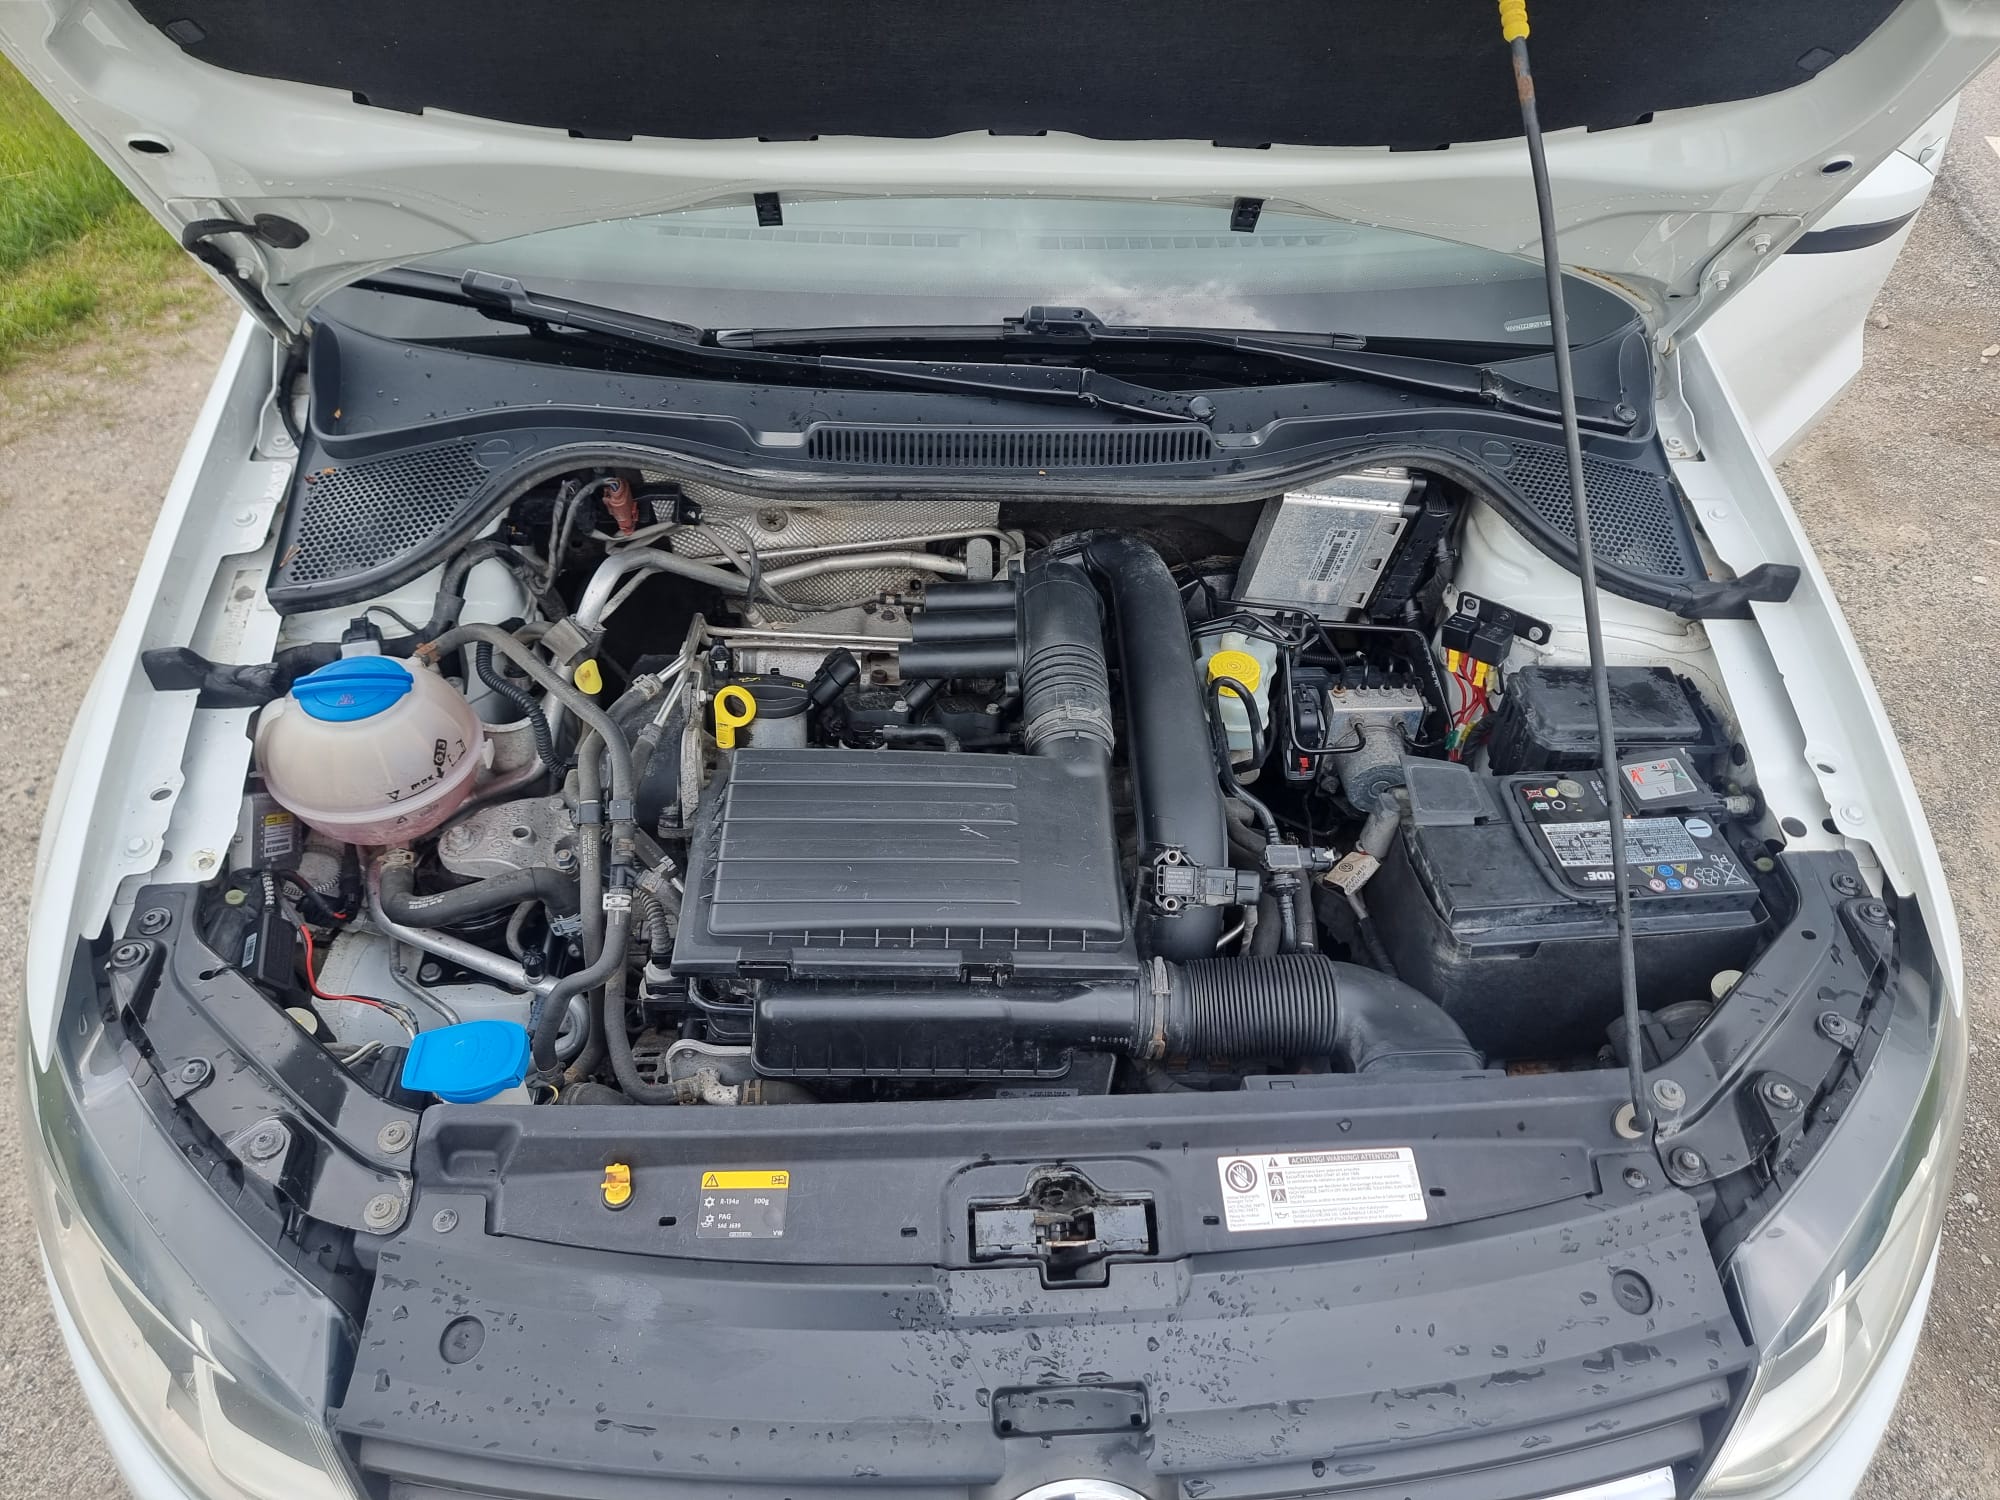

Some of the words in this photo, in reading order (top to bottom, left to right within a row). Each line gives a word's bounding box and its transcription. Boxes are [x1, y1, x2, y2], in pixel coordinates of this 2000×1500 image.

[411, 774, 434, 790] max
[1291, 1155, 1325, 1165] ACHTUNG!
[1326, 1154, 1360, 1163] WARNING!
[1360, 1152, 1398, 1162] ATTENTION!
